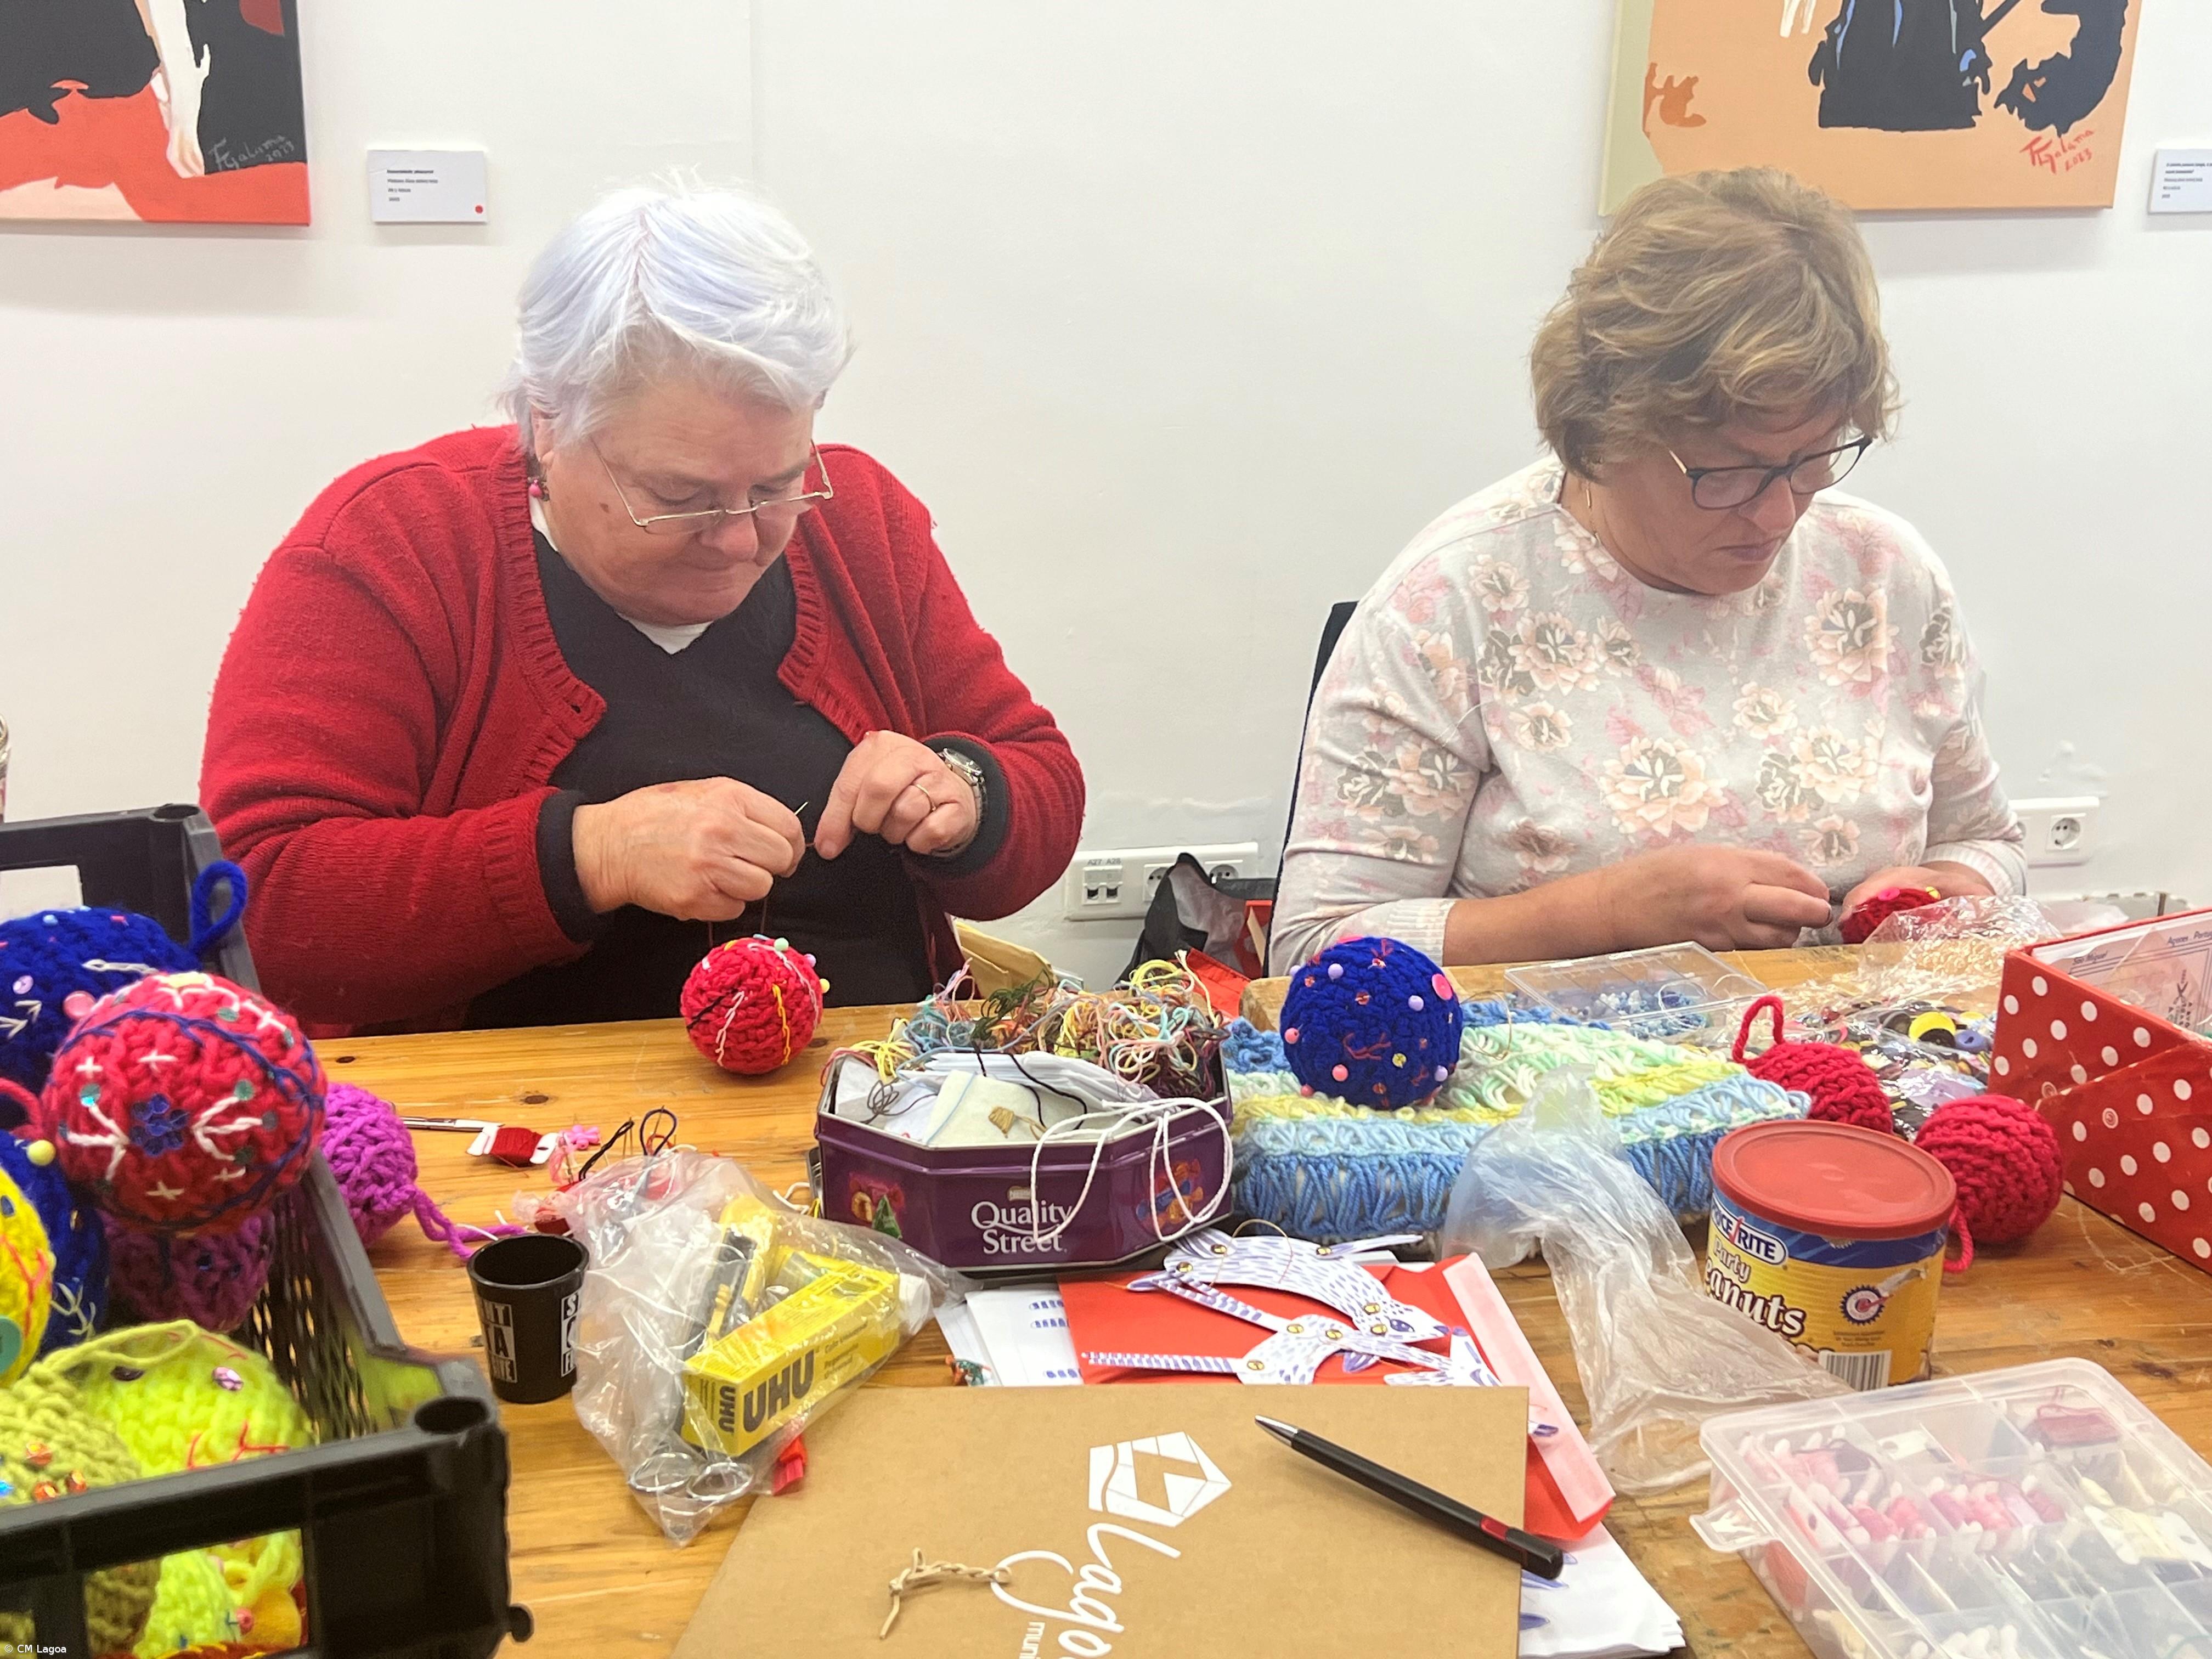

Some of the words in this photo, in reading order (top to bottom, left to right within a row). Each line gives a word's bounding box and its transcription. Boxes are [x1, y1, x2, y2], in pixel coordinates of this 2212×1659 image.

[971, 1200, 1073, 1234] Quality
[983, 1229, 1063, 1254] Street
[1713, 1235, 1751, 1283] Party
[1737, 1227, 1776, 1260] RITE
[718, 1385, 736, 1434] UHU
[743, 1349, 814, 1433] UHU
[990, 1522, 1181, 1659] Lago
